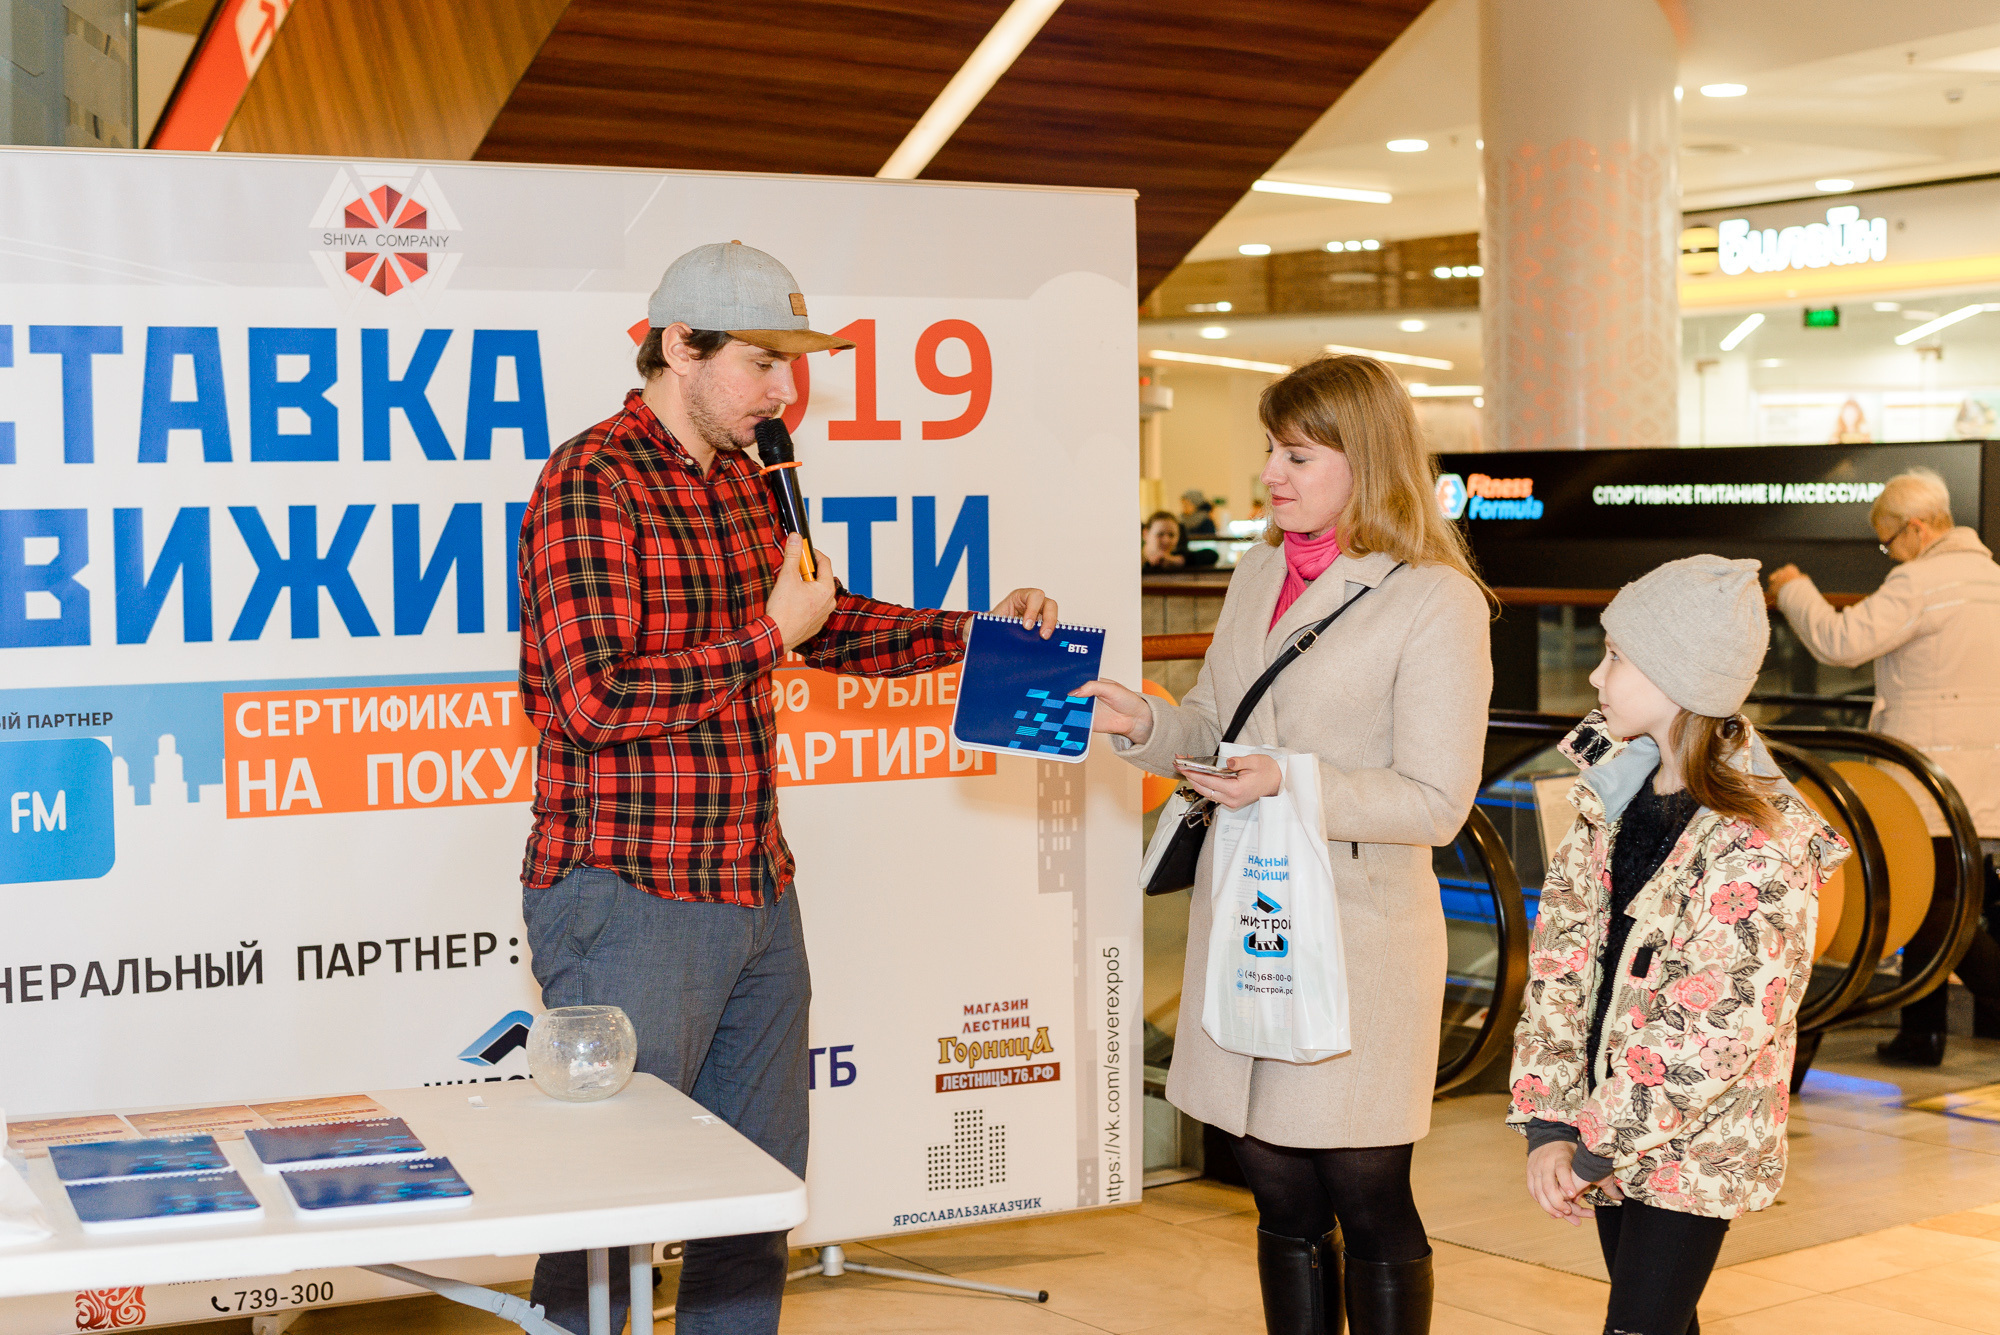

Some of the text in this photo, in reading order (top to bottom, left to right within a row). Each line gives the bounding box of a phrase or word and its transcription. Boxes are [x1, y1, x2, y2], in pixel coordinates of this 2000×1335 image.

[323, 232, 450, 248] SHIVA COMPANY
[0, 324, 551, 465] ТАВКА
[1468, 495, 1544, 520] Formula
[1593, 482, 1886, 506] СПОРТИВНОЕ ПИТАНИЕ И АКСЕССУАР
[1067, 643, 1089, 655] ВТБ
[235, 690, 518, 738] СЕРТИФИКАТ
[837, 671, 957, 710] РУБЛЕ
[27, 711, 113, 729] ПАРТНЕР
[238, 757, 323, 813] НА
[366, 746, 538, 806] ПОКУ
[10, 789, 67, 834] FM
[297, 931, 520, 982] ПАРТНЕР:
[963, 998, 1029, 1016] МАГАЗИН
[962, 1015, 1031, 1034] ЛЕСТНИЦ
[809, 1044, 857, 1090] ТБ
[893, 1197, 1042, 1227] ЯРОСЛАВЛЬЗАКАЗЧИК
[234, 1281, 334, 1312] 739-300
